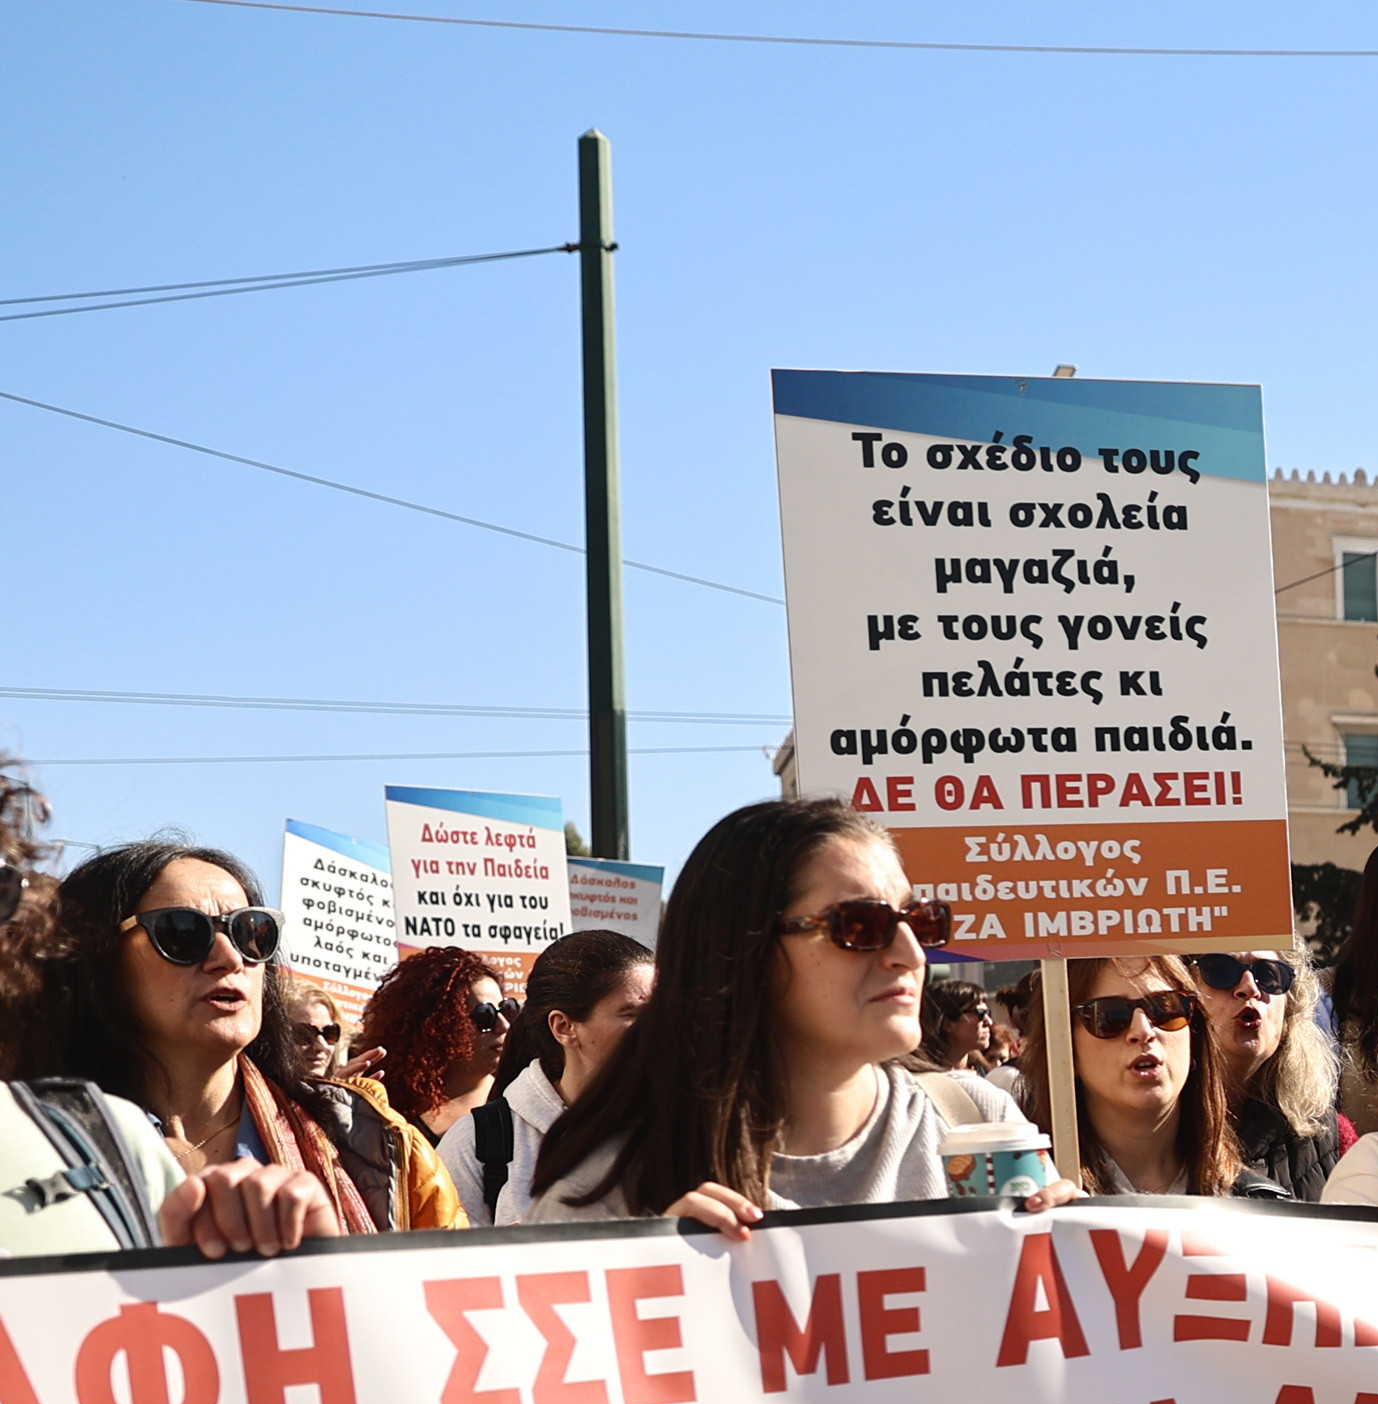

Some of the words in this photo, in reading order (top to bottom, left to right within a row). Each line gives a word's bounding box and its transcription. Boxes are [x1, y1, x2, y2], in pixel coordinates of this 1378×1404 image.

[851, 432, 908, 469] Το
[927, 431, 1081, 473] σχέδιο
[1098, 445, 1201, 484] τους
[872, 485, 991, 528] είναι
[1009, 491, 1188, 530] σχολεία
[935, 545, 1136, 594] μαγαζιά,
[867, 612, 921, 650] με
[938, 613, 1042, 649] τους
[1058, 601, 1207, 649] γονείς
[922, 658, 1103, 704] πελάτες
[1120, 668, 1163, 696] κι
[830, 714, 1077, 764] αμόρφωτα
[1095, 711, 1253, 753] παιδιά.
[851, 776, 915, 812] ΔΕ
[934, 775, 1003, 810] ΘΑ
[1021, 771, 1243, 808] ΠΕΡΑΣΕΙ!
[421, 822, 478, 846] Δώστε
[485, 826, 536, 852] λεφτά
[964, 833, 1141, 866] Σύλλογος
[411, 859, 439, 879] για
[446, 860, 477, 876] την
[483, 857, 549, 880] Παιδεία
[1166, 869, 1241, 894] Π.Ε.
[300, 876, 374, 906] σκυφτός
[417, 890, 447, 906] και
[453, 884, 480, 907] όχι
[486, 893, 513, 913] για
[520, 895, 548, 909] του
[404, 916, 455, 938] ΝΑΤΟ
[462, 923, 481, 938] τα
[488, 919, 564, 946] σφαγεία!
[1024, 906, 1229, 938] ΙΜΒΡΙΩΤΗ"
[314, 936, 355, 959] λαός
[361, 951, 388, 965] και
[751, 1266, 931, 1394] ΜΕ
